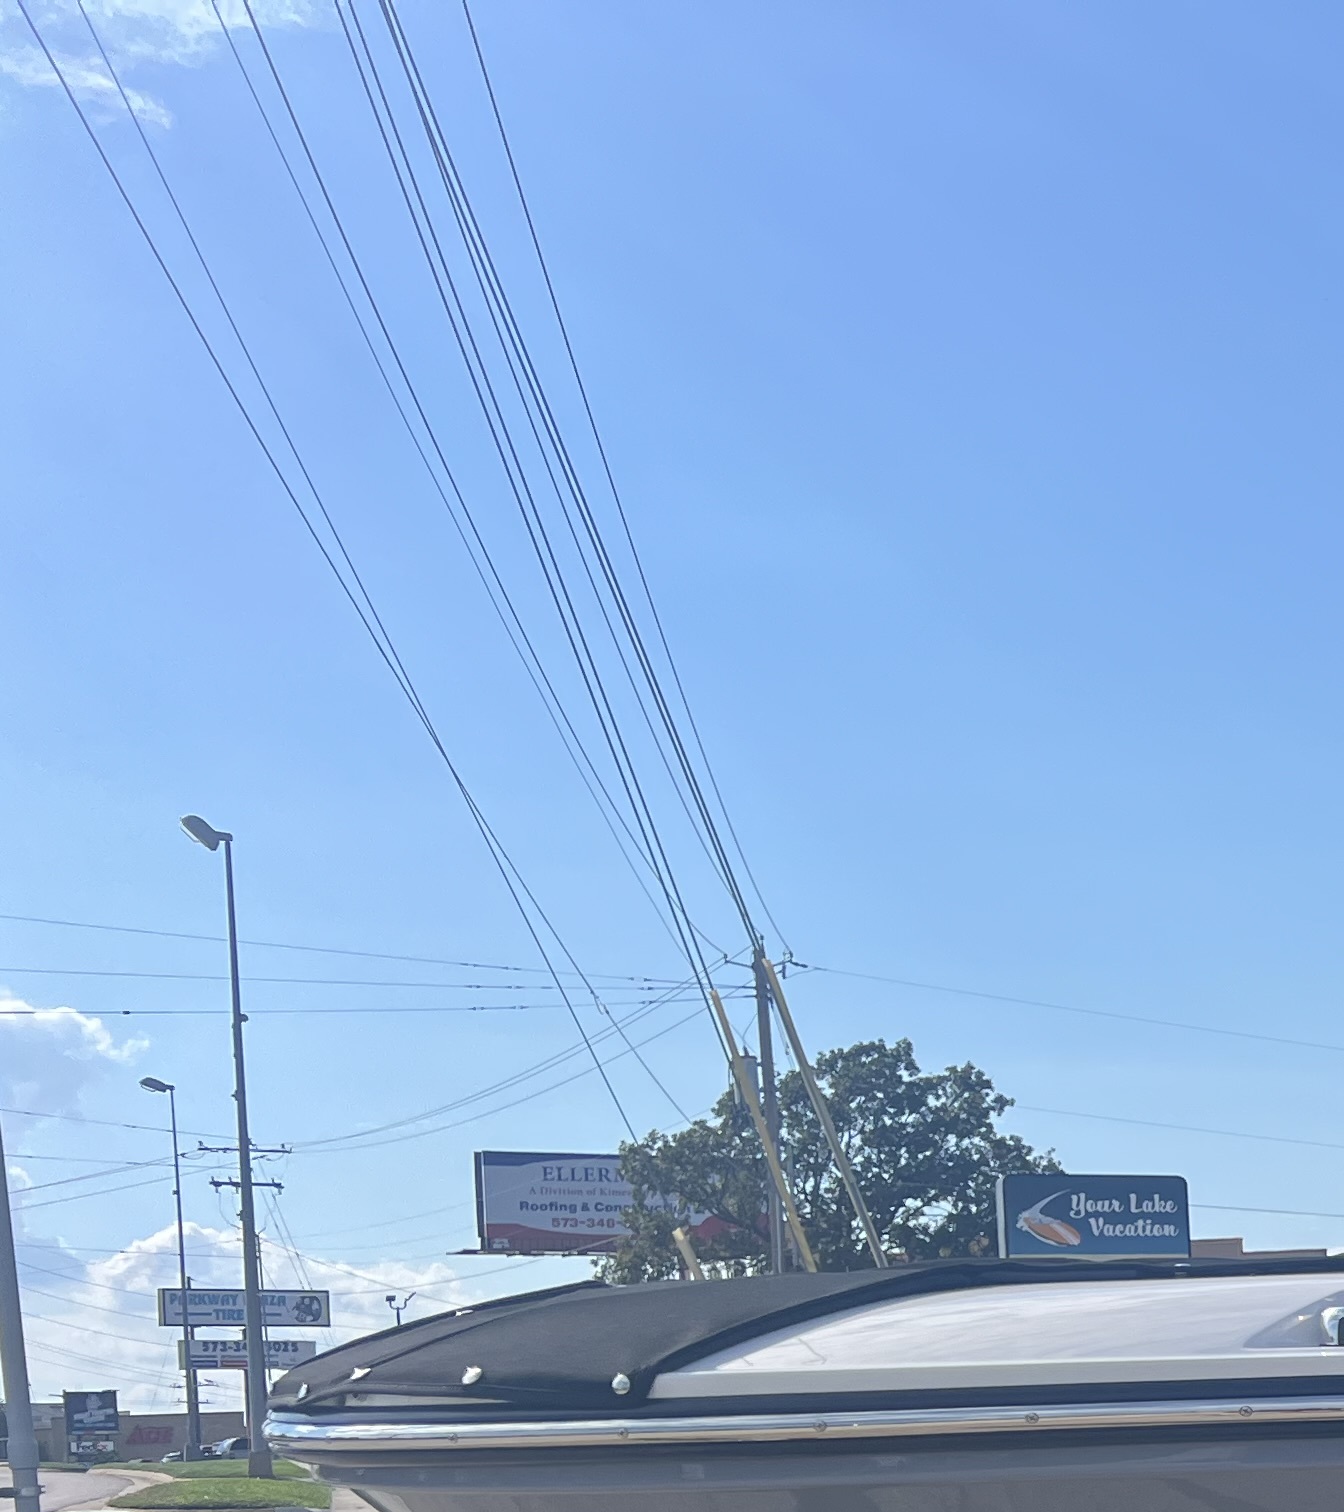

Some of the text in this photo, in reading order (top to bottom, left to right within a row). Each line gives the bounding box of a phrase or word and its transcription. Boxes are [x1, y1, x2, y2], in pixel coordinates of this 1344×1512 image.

[542, 1166, 627, 1183] ELLERM
[529, 1187, 537, 1196] A
[540, 1187, 584, 1197] Division
[586, 1187, 597, 1197] of
[519, 1201, 578, 1214] Roofing
[581, 1202, 590, 1212] &
[1069, 1192, 1179, 1218] Your Lake
[552, 1217, 623, 1229] 573-340-
[1088, 1217, 1180, 1238] Vacation
[212, 1308, 245, 1321] TIRE
